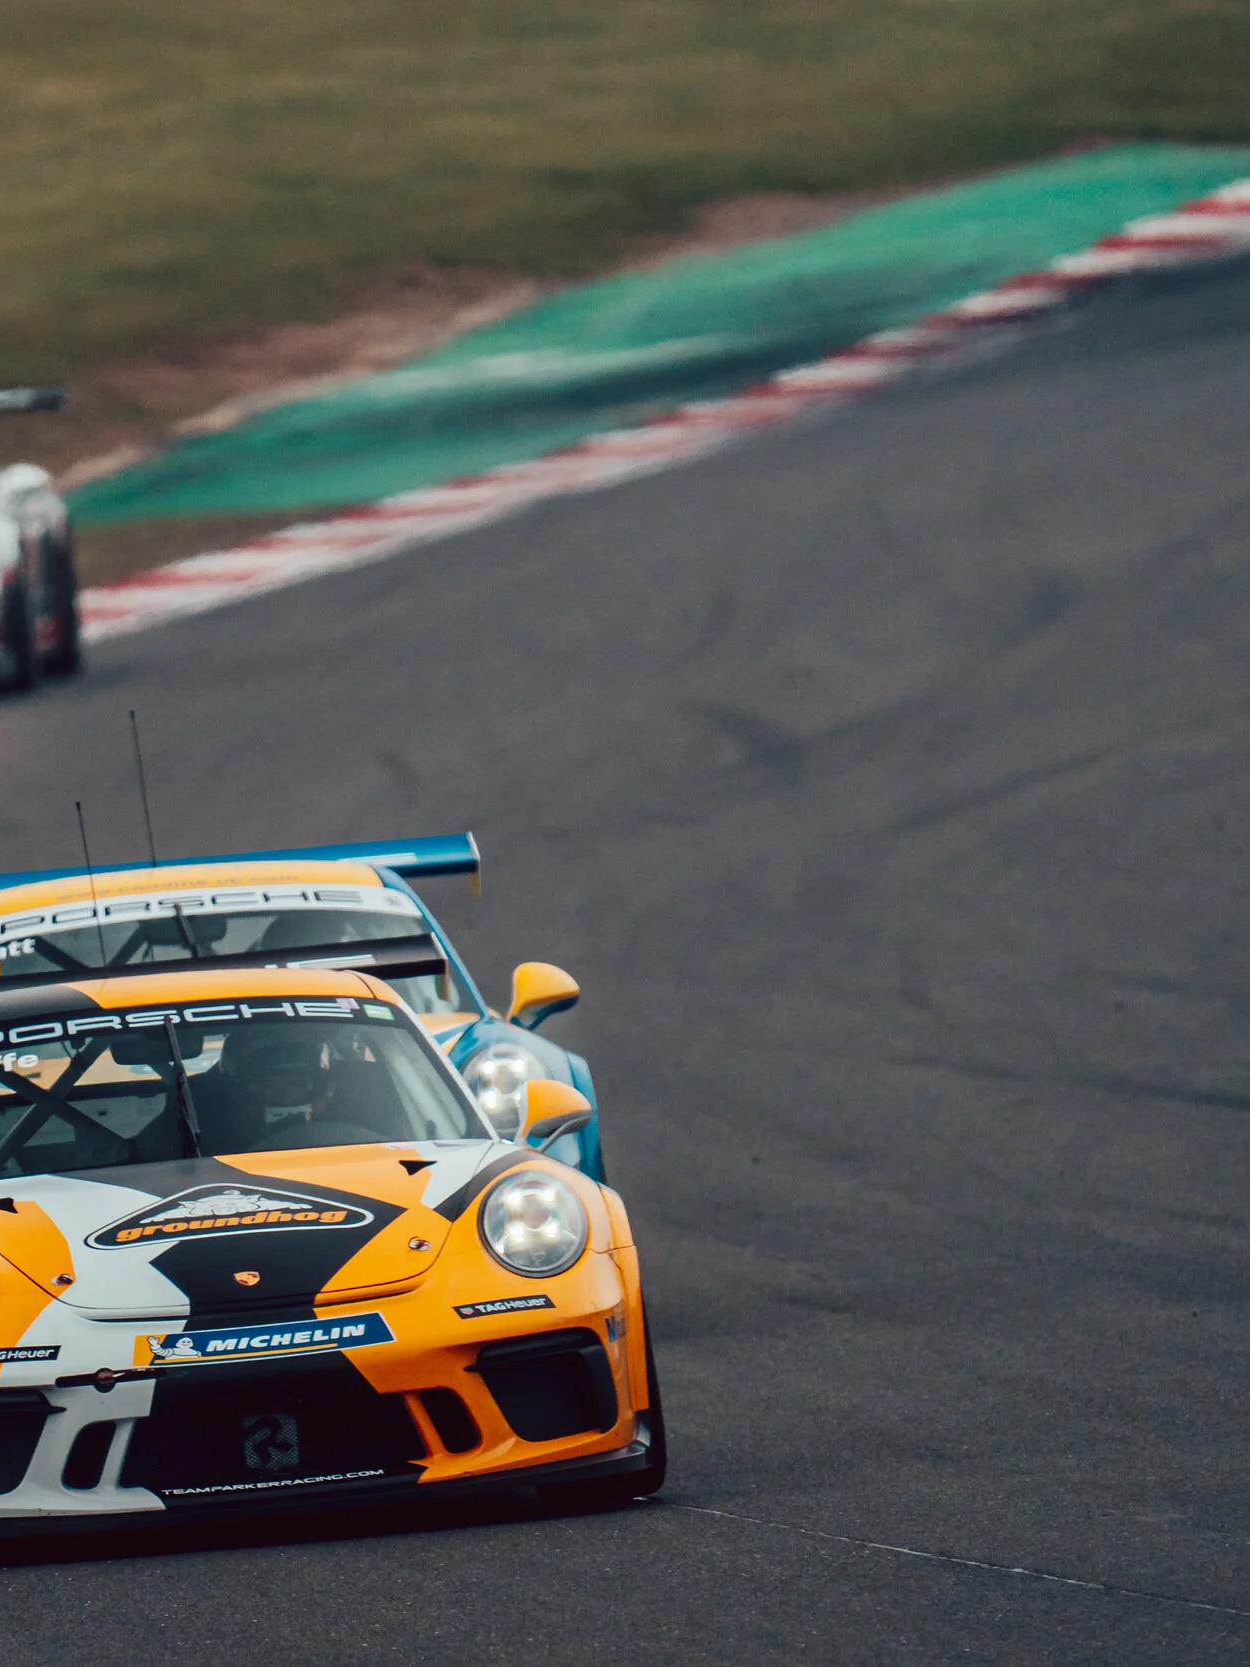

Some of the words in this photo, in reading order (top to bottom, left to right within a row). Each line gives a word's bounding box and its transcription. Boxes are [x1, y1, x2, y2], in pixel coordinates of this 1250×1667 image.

[0, 889, 362, 935] PORSCHE
[115, 1210, 348, 1242] groundhog
[206, 1324, 366, 1352] MICHELIN
[161, 1468, 385, 1496] TEAMPARKERRACING.COM
